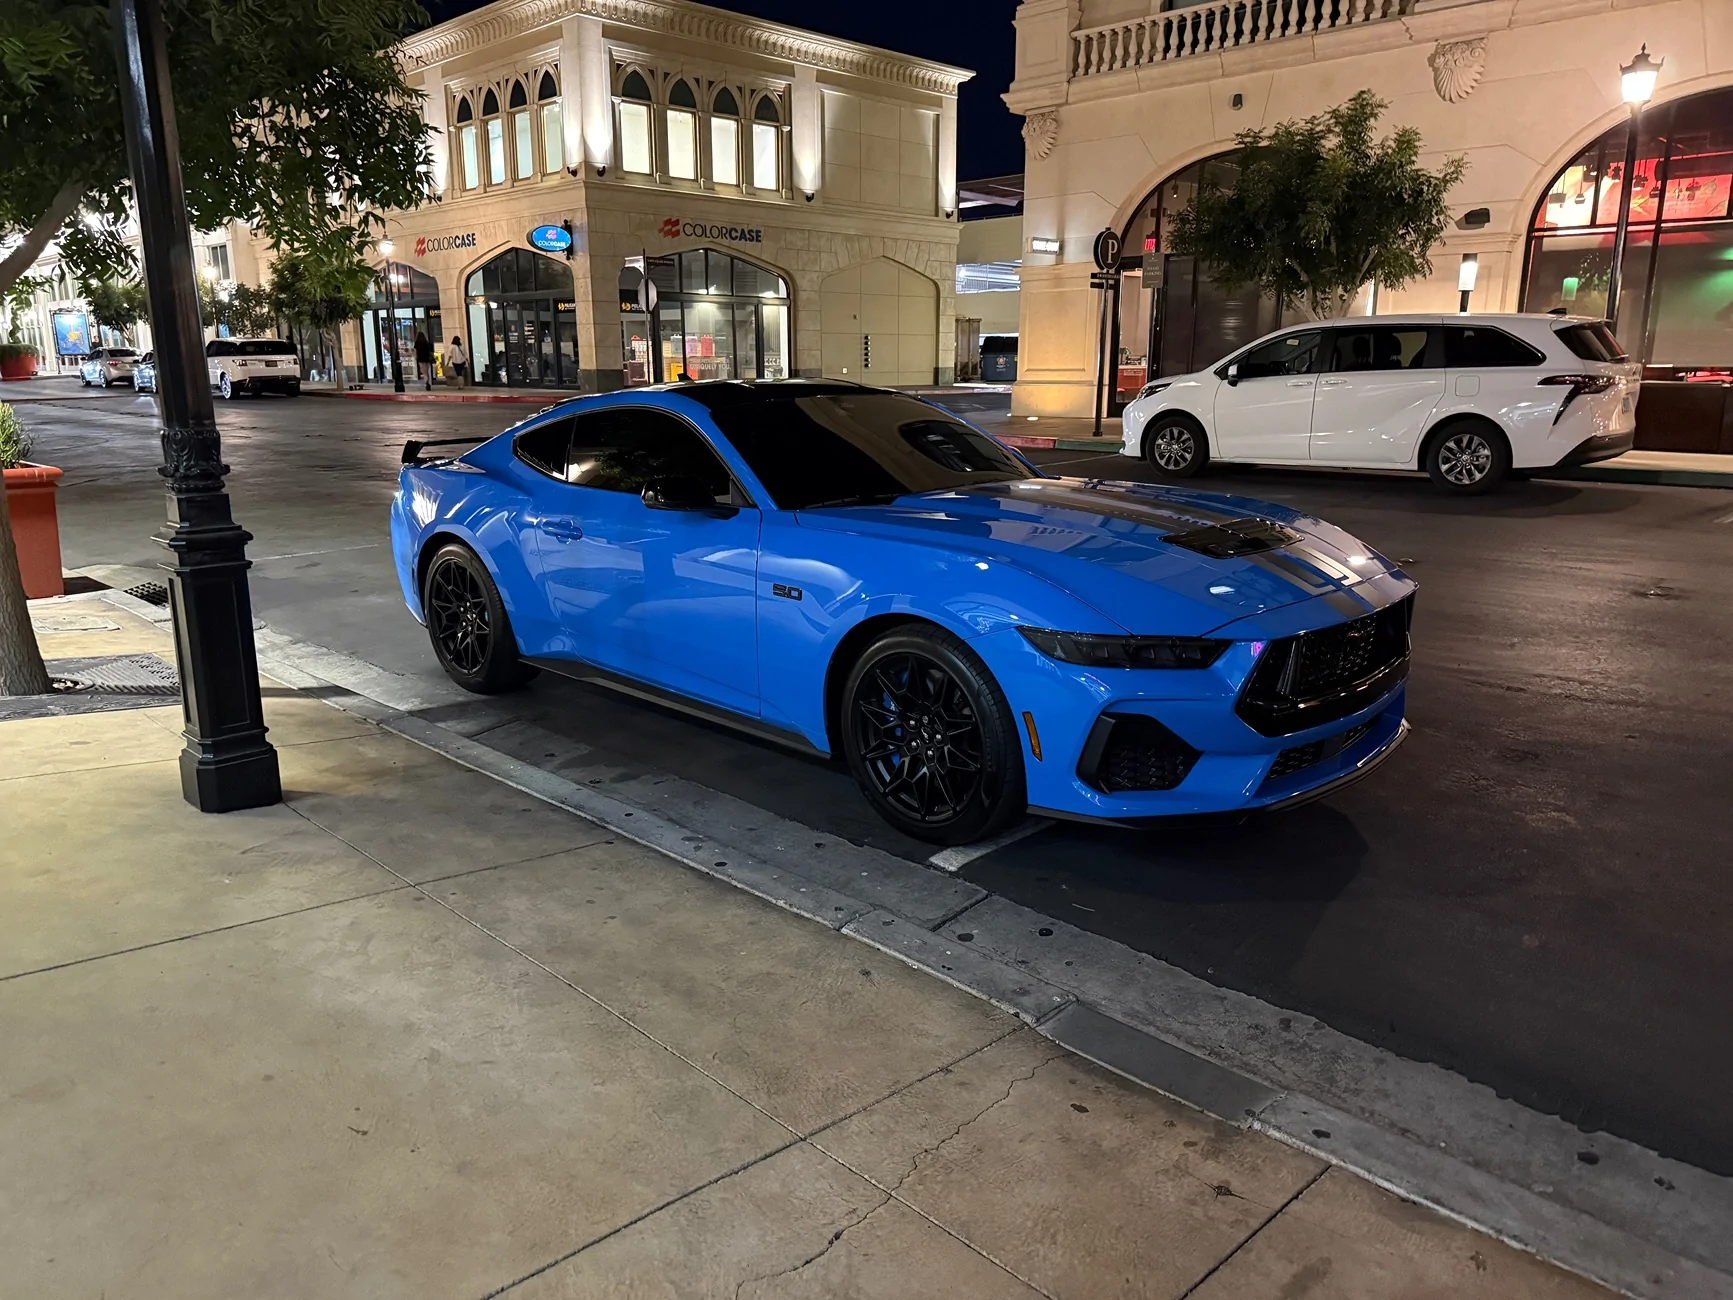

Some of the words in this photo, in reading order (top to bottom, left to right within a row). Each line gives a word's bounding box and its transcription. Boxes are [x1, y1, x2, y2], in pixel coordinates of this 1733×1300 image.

[426, 232, 476, 252] COLORCASE
[682, 222, 762, 243] COLORCASE
[538, 240, 566, 248] COLORCASE
[1106, 239, 1118, 264] P
